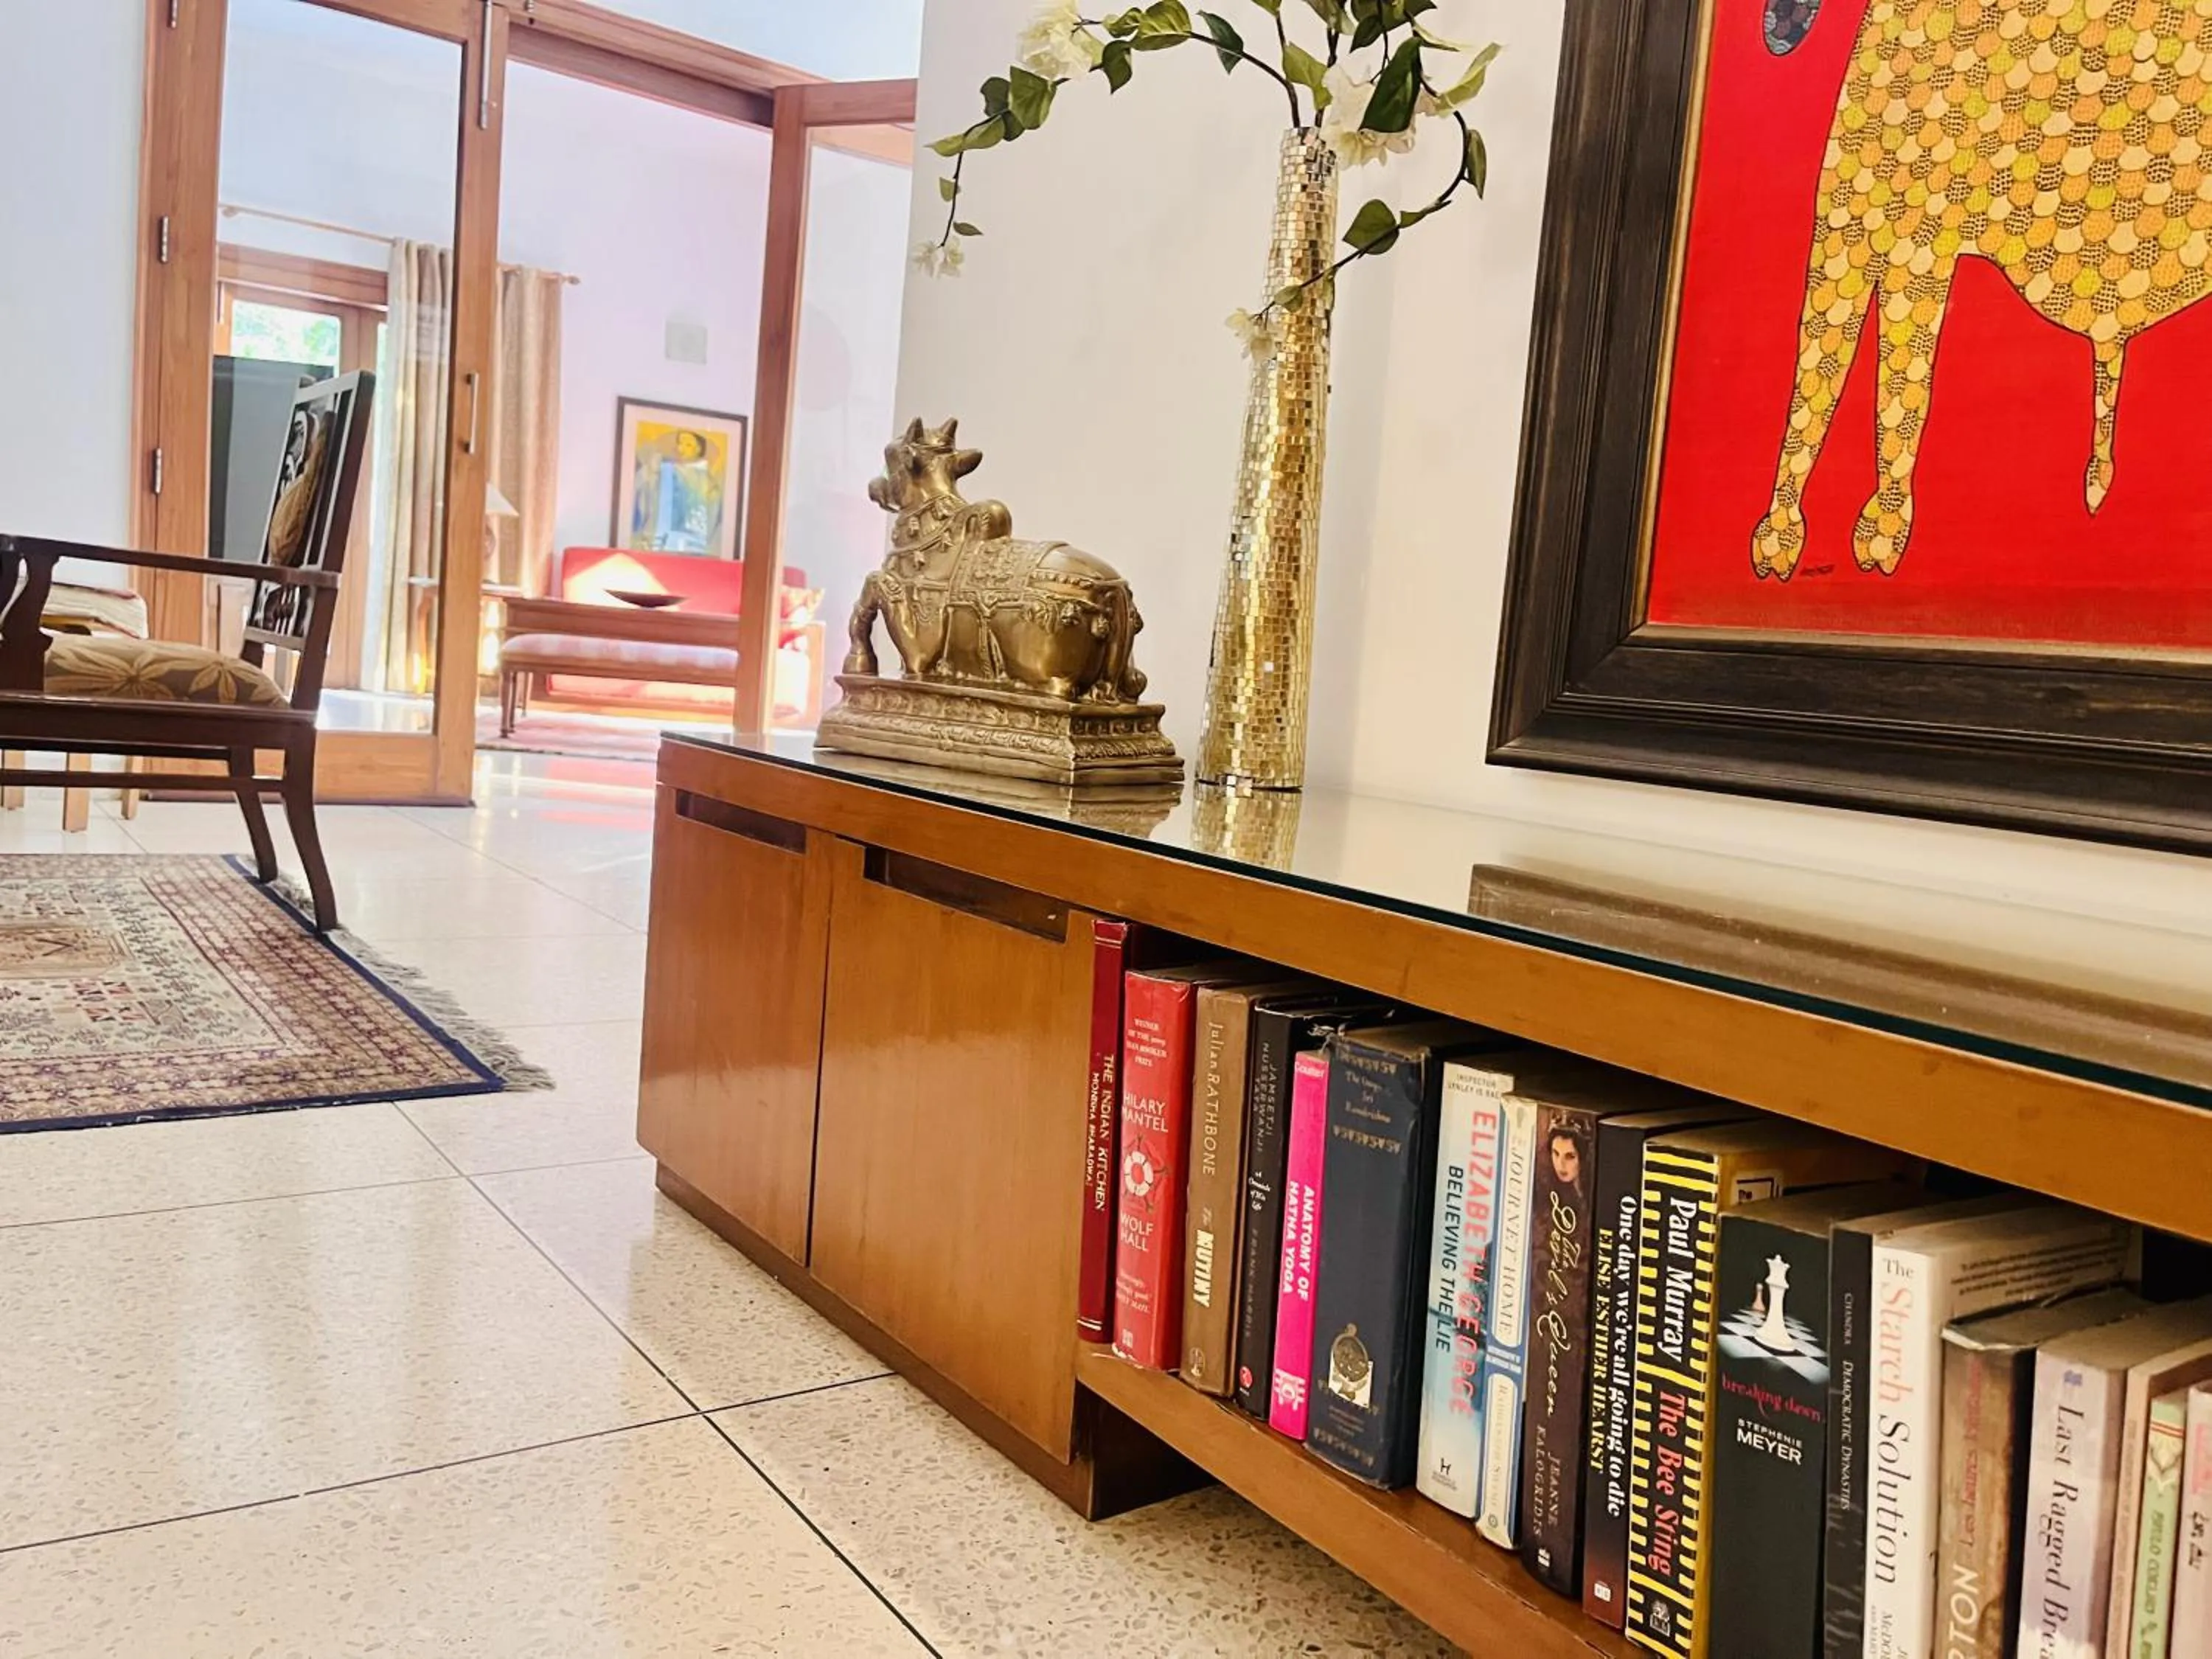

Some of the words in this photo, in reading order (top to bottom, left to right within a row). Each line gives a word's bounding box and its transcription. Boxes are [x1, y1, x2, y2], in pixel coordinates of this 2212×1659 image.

[1103, 1054, 1114, 1084] THE
[1209, 1022, 1225, 1068] Julian
[1100, 1090, 1112, 1139] INDIAN
[1122, 1105, 1169, 1133] MANTEL
[1124, 1092, 1166, 1116] HILARY
[1203, 1073, 1220, 1175] RATHBONE
[1266, 1064, 1277, 1136] JAMSETJI
[1095, 1146, 1108, 1211] KITCHEN
[1463, 1110, 1496, 1284] ELIZABETH
[1505, 1146, 1525, 1259] JOURNEY
[1120, 1212, 1154, 1236] WOLF
[1120, 1229, 1149, 1252] HALL
[1285, 1181, 1299, 1245] HATHA
[1301, 1186, 1315, 1273] ANATOMY
[1442, 1165, 1464, 1272] BELIEVING
[1618, 1195, 1637, 1241] One
[1667, 1196, 1697, 1259] Paul
[1193, 1228, 1214, 1308] MUTINY
[1283, 1248, 1295, 1294] YOGA
[1298, 1279, 1310, 1301] OF
[1597, 1228, 1613, 1290] ELISE
[1613, 1244, 1635, 1286] day
[1883, 1257, 1915, 1279] The
[1439, 1277, 1455, 1315] THE
[1499, 1264, 1518, 1341] HOME
[1615, 1291, 1633, 1354] we're
[1658, 1265, 1694, 1363] Murray
[1436, 1317, 1452, 1353] LIE
[1449, 1293, 1484, 1417] GEORGE
[1537, 1310, 1571, 1418] Queen
[1593, 1294, 1610, 1380] ESTHER
[1879, 1281, 1914, 1402] Starch
[1613, 1355, 1630, 1387] all
[1722, 1372, 1783, 1418] breaking
[1590, 1384, 1607, 1475] HEARST
[1607, 1386, 1628, 1455] going
[1660, 1391, 1686, 1439] The
[1738, 1417, 1803, 1449] STEPHENIE
[2056, 1405, 2085, 1467] Last
[1610, 1455, 1624, 1478] to
[1657, 1444, 1683, 1497] Bee
[1736, 1427, 1803, 1466] MEYER
[1534, 1424, 1546, 1538] KALOGRIDIS
[1548, 1451, 1561, 1527] JEANNE
[1607, 1481, 1625, 1517] die
[1875, 1413, 1912, 1585] Solution
[1648, 1503, 1680, 1577] Sting
[2039, 1478, 2079, 1592] Ragged
